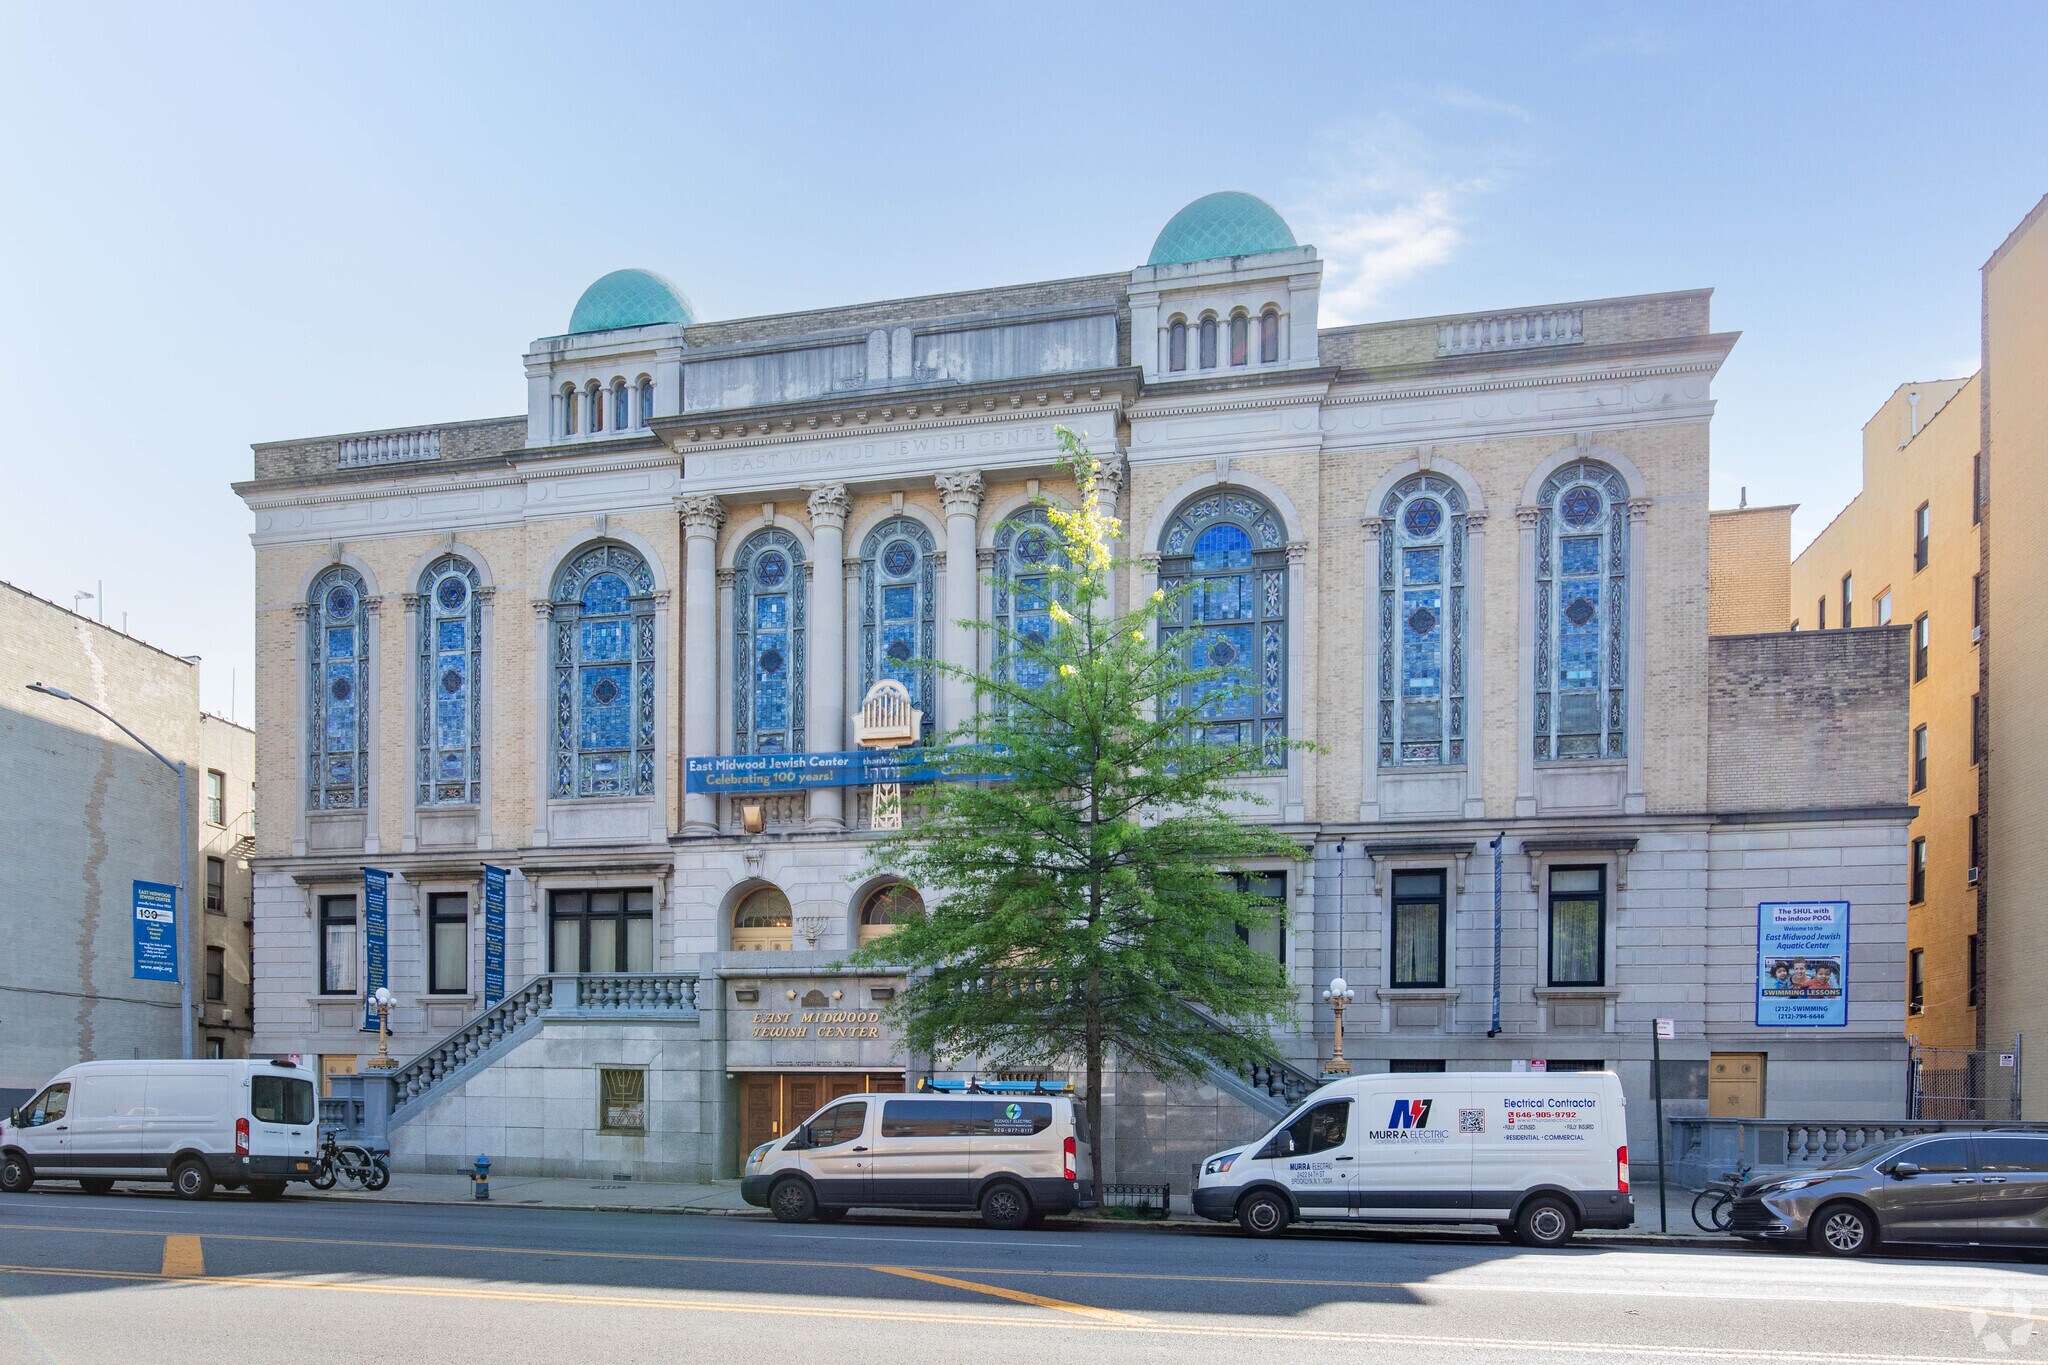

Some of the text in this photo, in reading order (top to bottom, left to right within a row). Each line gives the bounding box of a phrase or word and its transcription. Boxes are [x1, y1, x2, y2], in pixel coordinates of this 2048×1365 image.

[730, 454, 778, 471] EAST
[789, 444, 874, 466] MIDWOOD
[888, 436, 966, 456] JEWISH
[690, 756, 849, 772] East Midwood Jewish Center
[863, 756, 887, 765] thank
[706, 770, 833, 786] Celebrating 100 years!
[139, 909, 158, 919] 100
[1776, 942, 1804, 950] Aquatic
[140, 965, 172, 973] www.emjc.org
[752, 1011, 879, 1023] EAST MIDWOOD
[752, 1026, 879, 1038] JEWISH CENTER
[1504, 1098, 1596, 1108] Electrical Contractor
[1370, 1130, 1449, 1139] MURRA ELECTRIC
